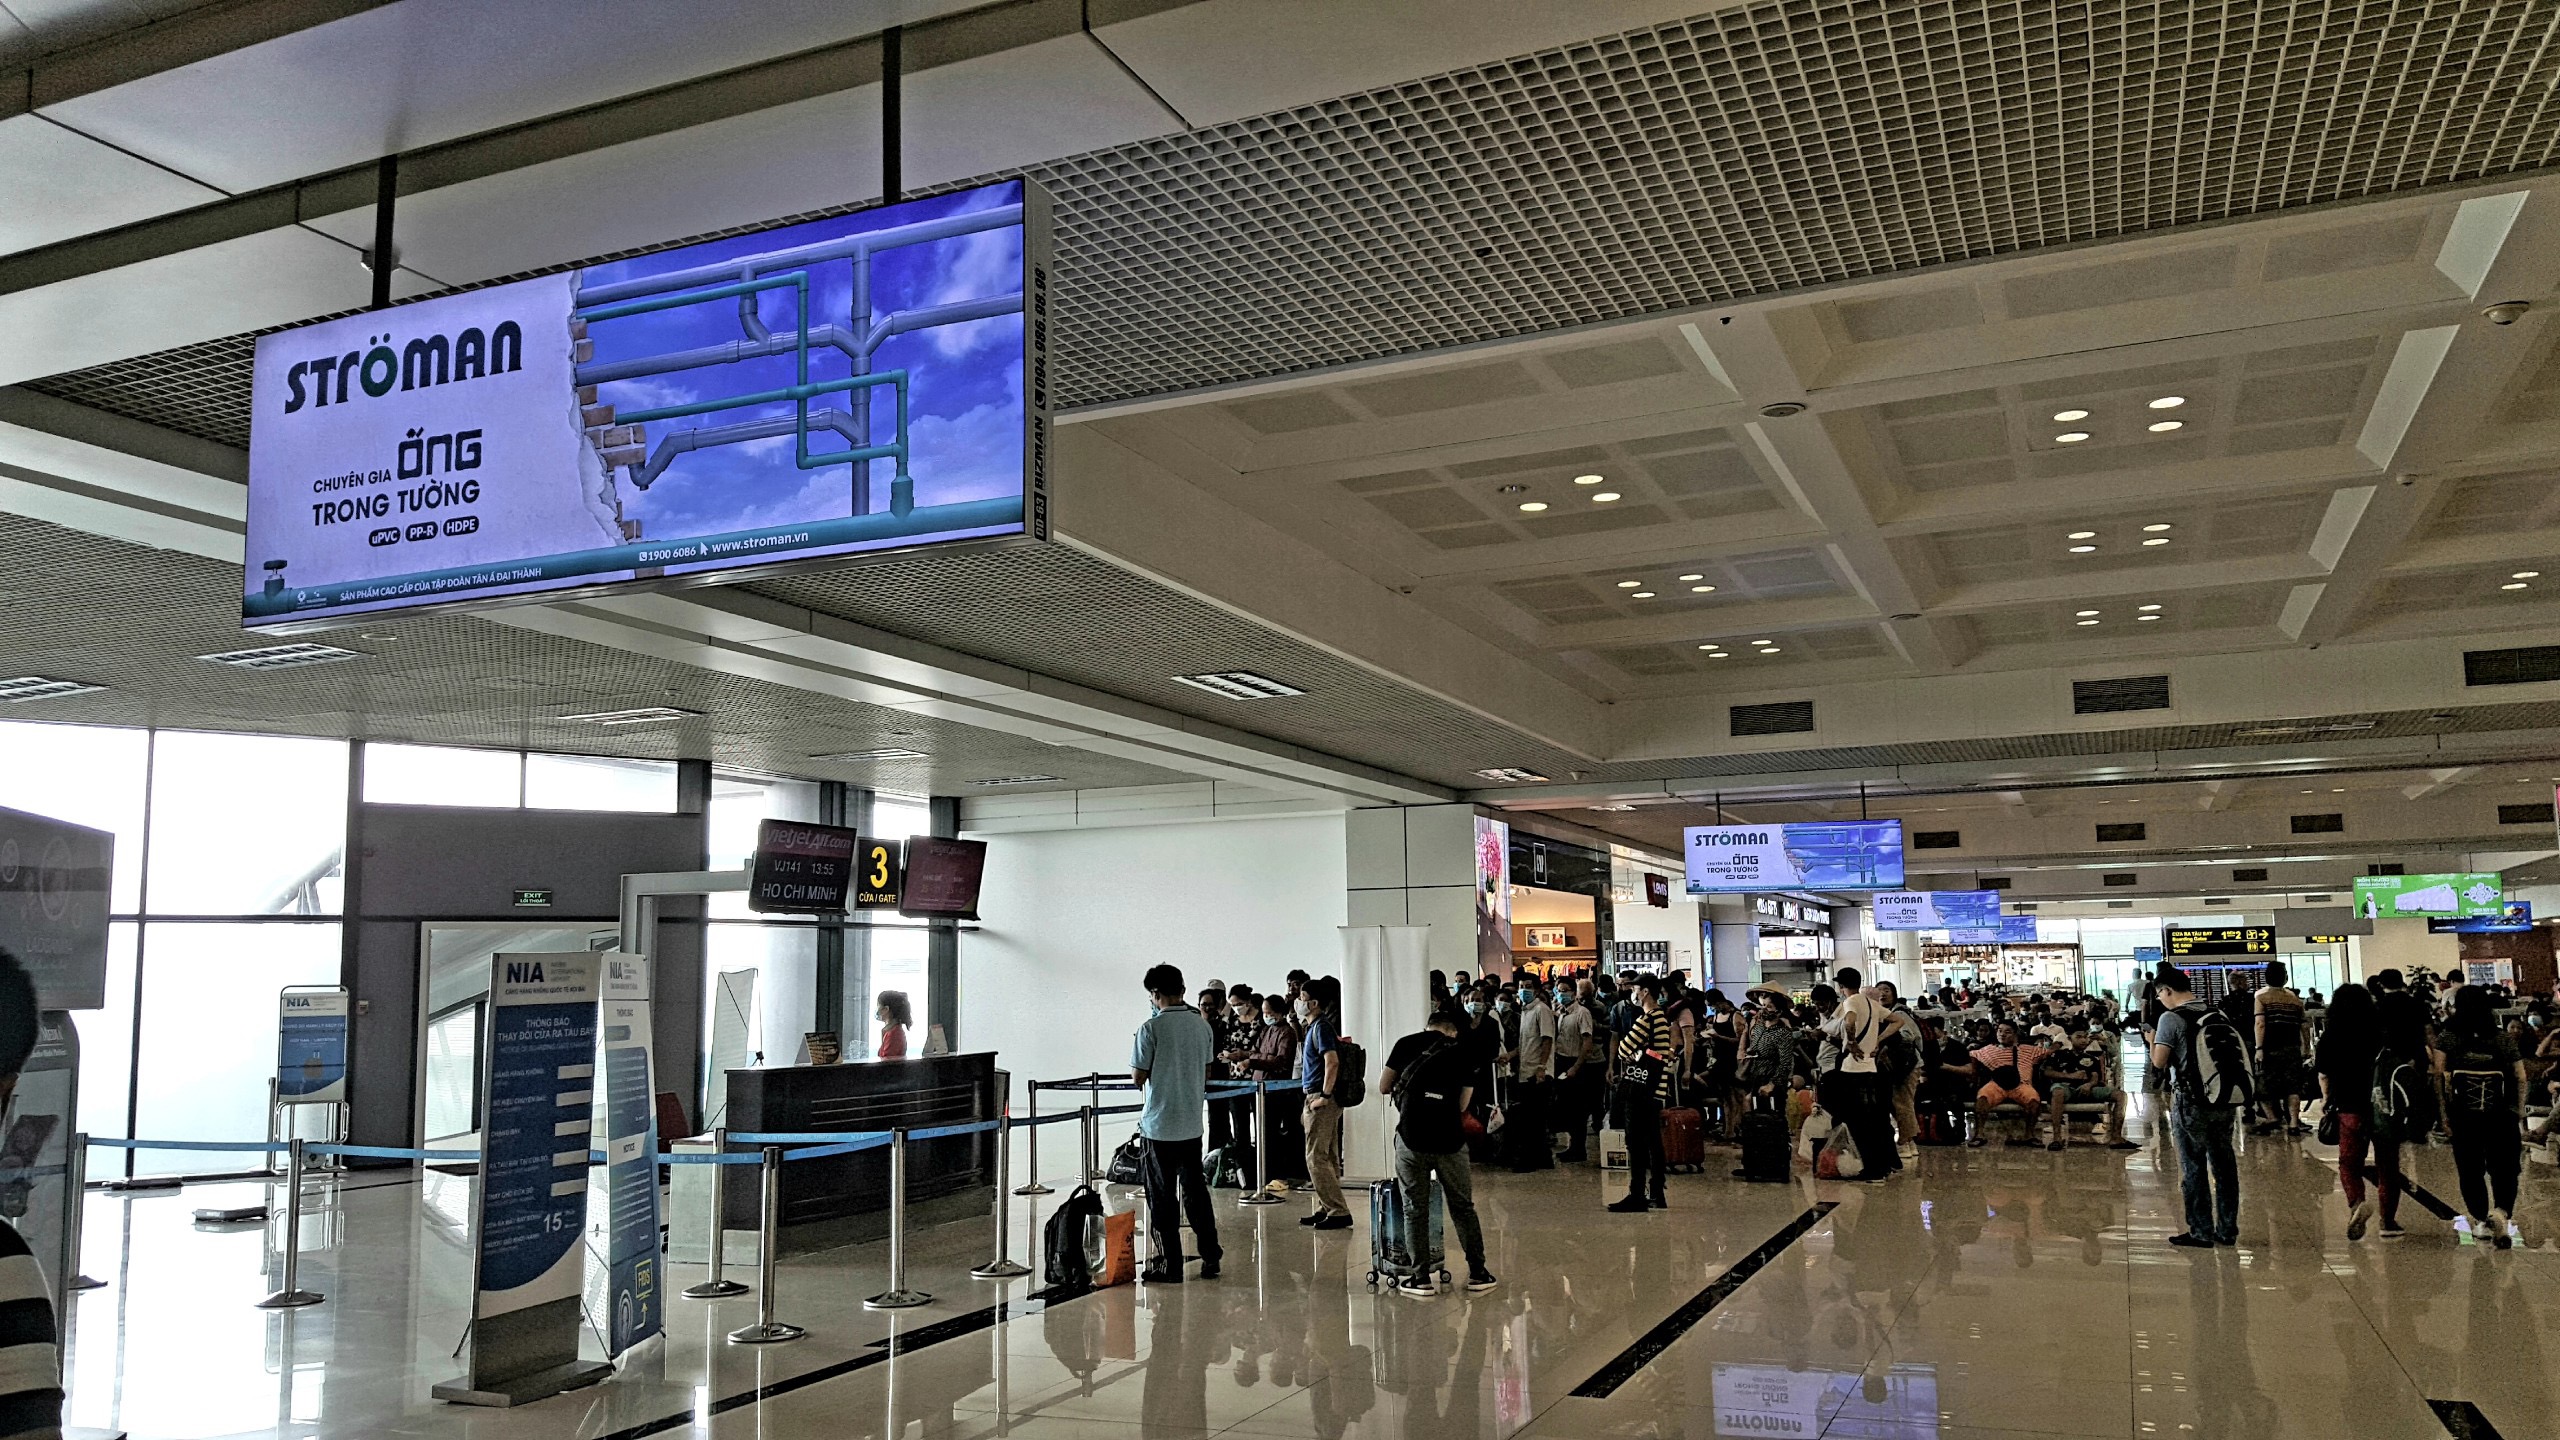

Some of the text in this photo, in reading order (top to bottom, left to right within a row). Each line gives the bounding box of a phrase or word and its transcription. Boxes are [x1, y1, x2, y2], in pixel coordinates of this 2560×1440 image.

[313, 426, 483, 493] CHUYÊN GIA ỐNG
[1034, 415, 1046, 491] BIZMAN
[312, 478, 481, 526] TRONG TƯỜNG
[371, 518, 476, 544] uPVC PP-R HDPE
[712, 532, 809, 553] www.stroman.vn
[648, 546, 696, 561] 1900 6086
[380, 586, 396, 597] CAO
[774, 859, 835, 876] VJ141 13:55
[869, 846, 888, 889] 3
[761, 882, 838, 901] HO CHI MINH
[858, 891, 874, 903] CỬA
[878, 893, 896, 904] GATE
[2221, 930, 2227, 940] 1
[2235, 930, 2242, 940] 2
[506, 962, 545, 984] NIA
[609, 961, 623, 980] NIA
[286, 998, 310, 1007] NIA
[498, 1031, 518, 1042] THAY
[552, 1029, 563, 1038] RA
[543, 1211, 563, 1233] 15
